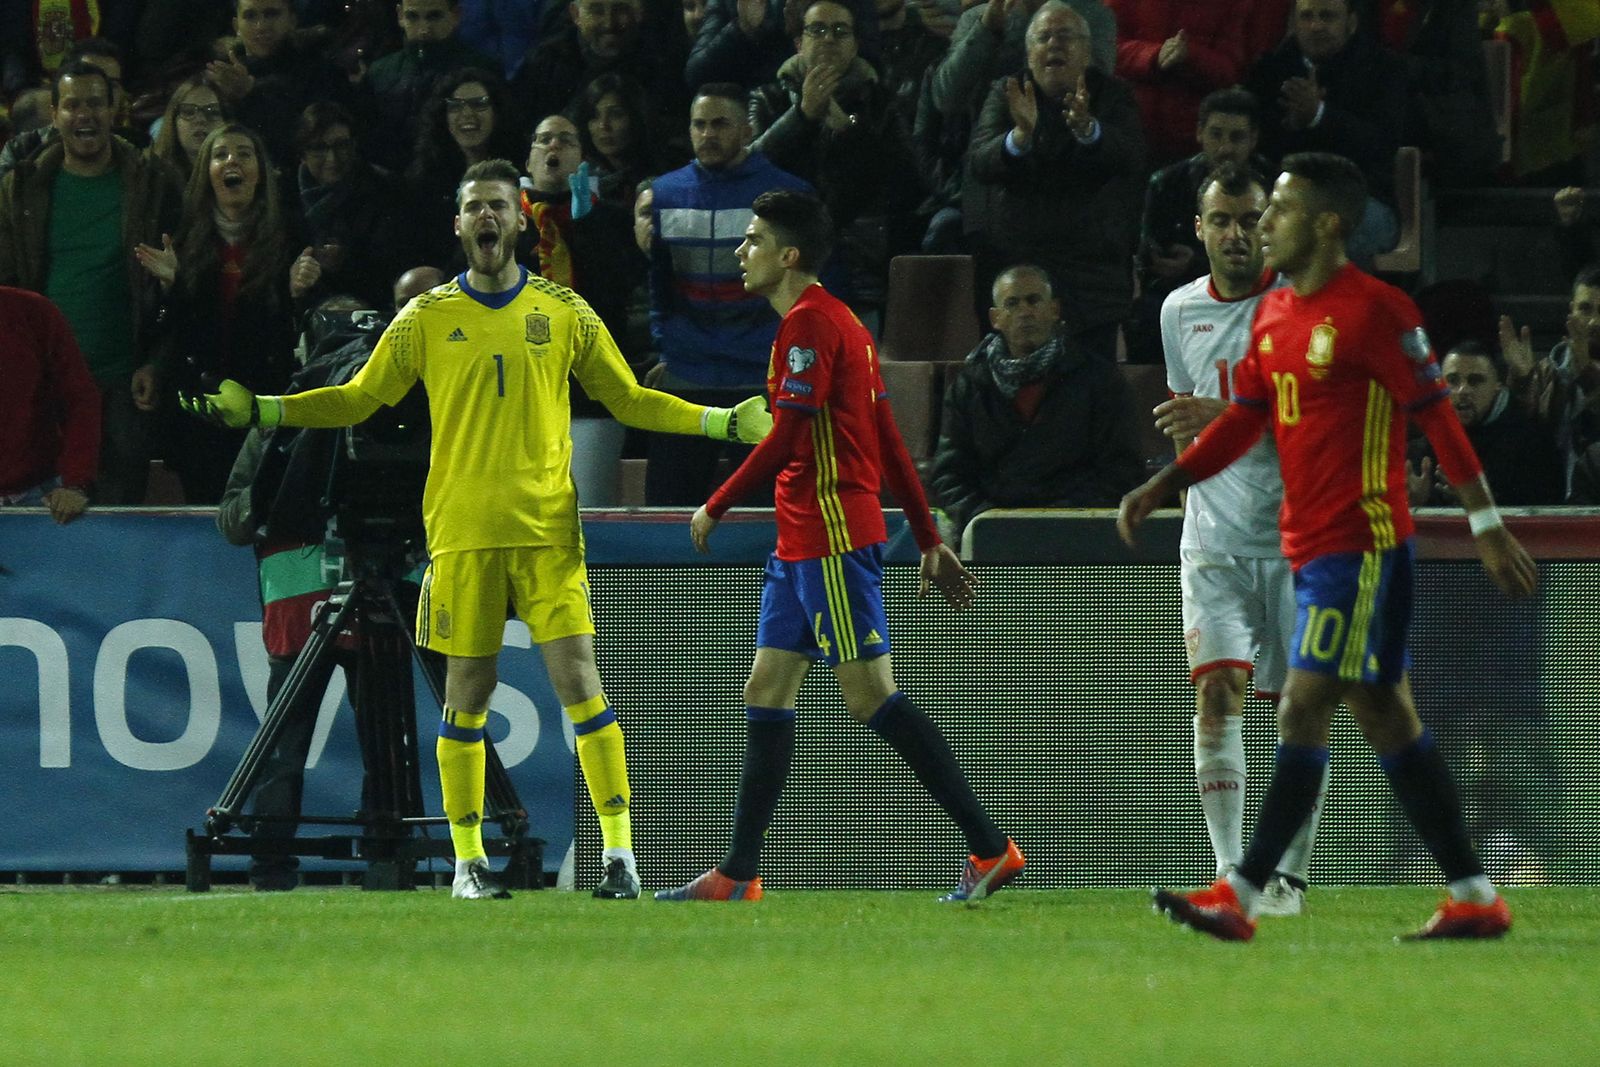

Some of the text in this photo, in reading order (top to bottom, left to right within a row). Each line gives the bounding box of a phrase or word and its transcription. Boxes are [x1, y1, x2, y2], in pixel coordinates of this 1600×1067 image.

[1191, 323, 1214, 333] JAKO
[493, 354, 504, 397] 1
[1271, 371, 1300, 426] 10
[814, 612, 831, 657] 4
[1299, 604, 1345, 662] 10
[1201, 780, 1239, 793] JAKO
